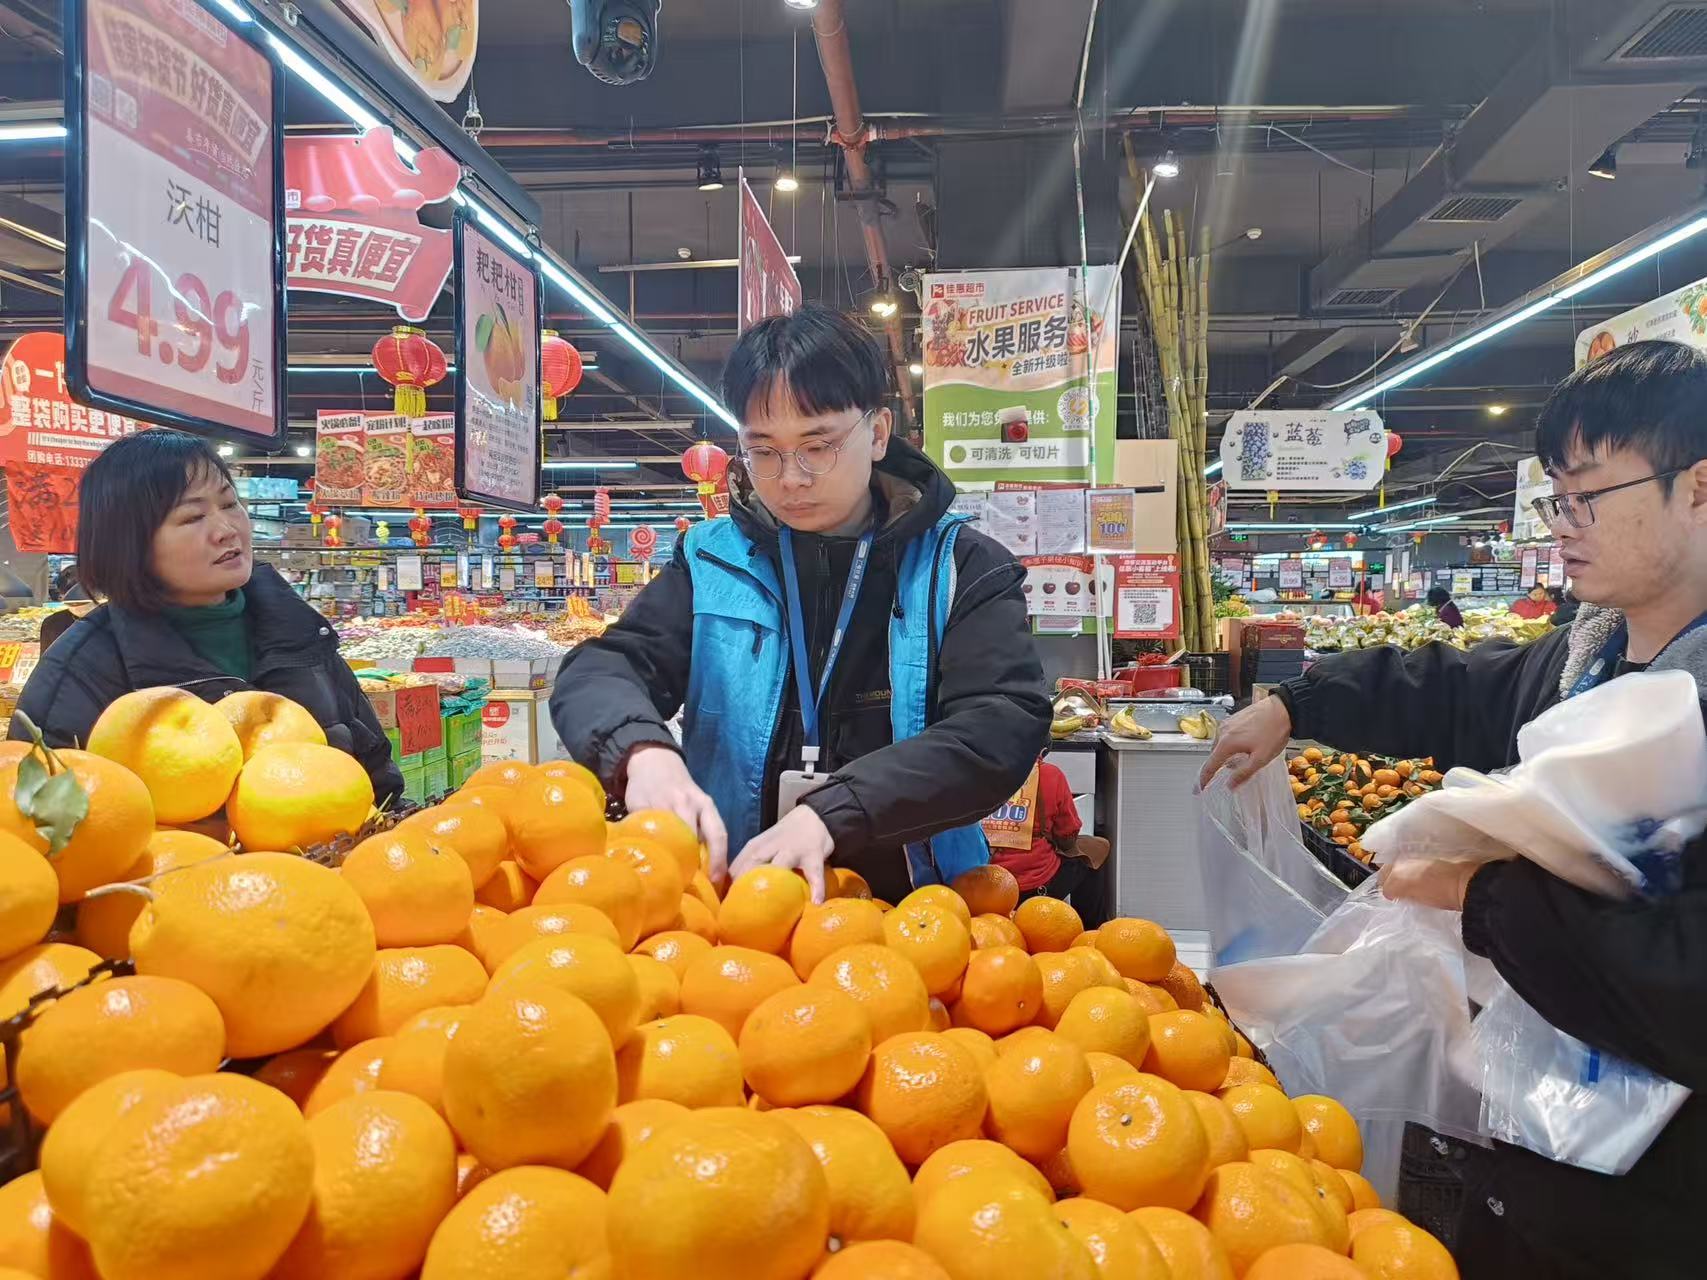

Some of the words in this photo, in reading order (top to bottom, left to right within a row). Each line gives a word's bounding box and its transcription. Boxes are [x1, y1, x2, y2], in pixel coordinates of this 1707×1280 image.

[166, 178, 222, 248] 沃柑
[946, 283, 985, 294] 佳惠超市
[108, 256, 249, 385] 4.99
[969, 304, 1007, 324] FRUIT
[1010, 293, 1064, 317] SERVICE
[966, 316, 1067, 364] 水果服务
[252, 358, 264, 412] 元/斤
[942, 409, 1049, 427] 我们为您免提供:
[971, 446, 1012, 461] 可清洗
[1020, 445, 1060, 460] 可切片
